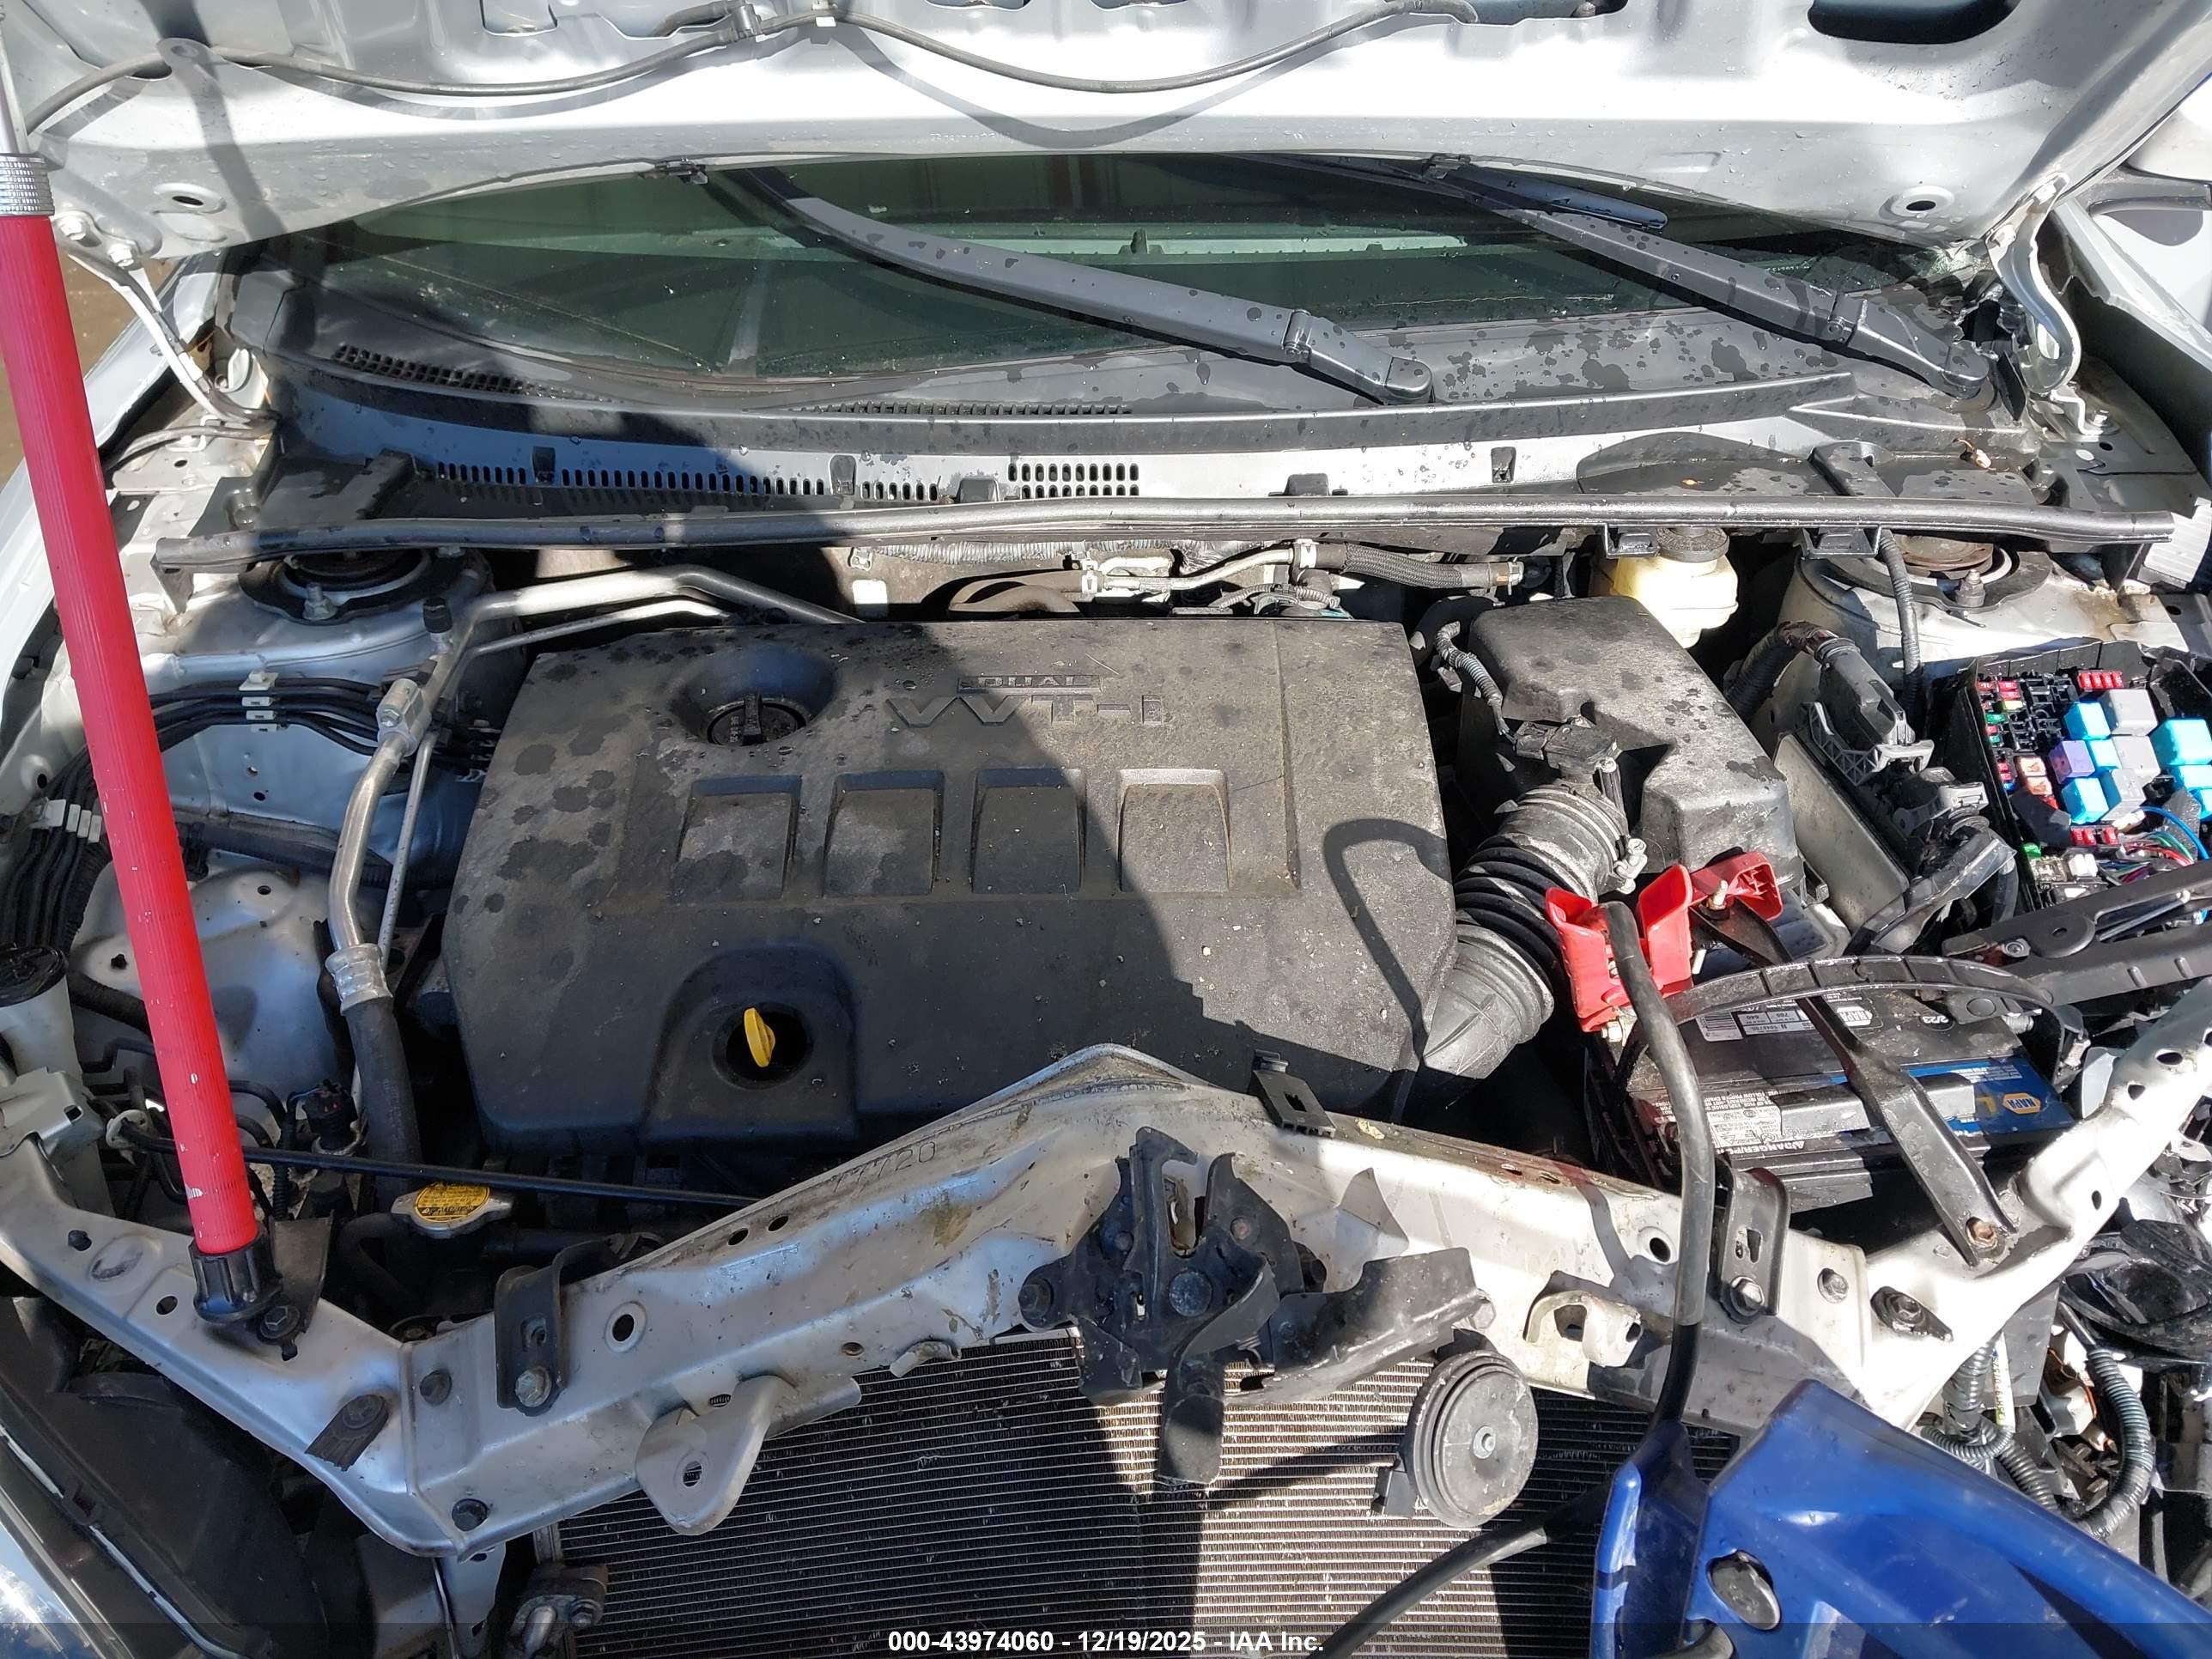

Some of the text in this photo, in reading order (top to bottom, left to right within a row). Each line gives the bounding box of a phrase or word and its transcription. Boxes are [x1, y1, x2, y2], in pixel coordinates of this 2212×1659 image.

[1839, 1010, 1869, 1023] NAPA
[1923, 1015, 1949, 1024] 2/23
[2007, 1098, 2037, 1109] NAPA
